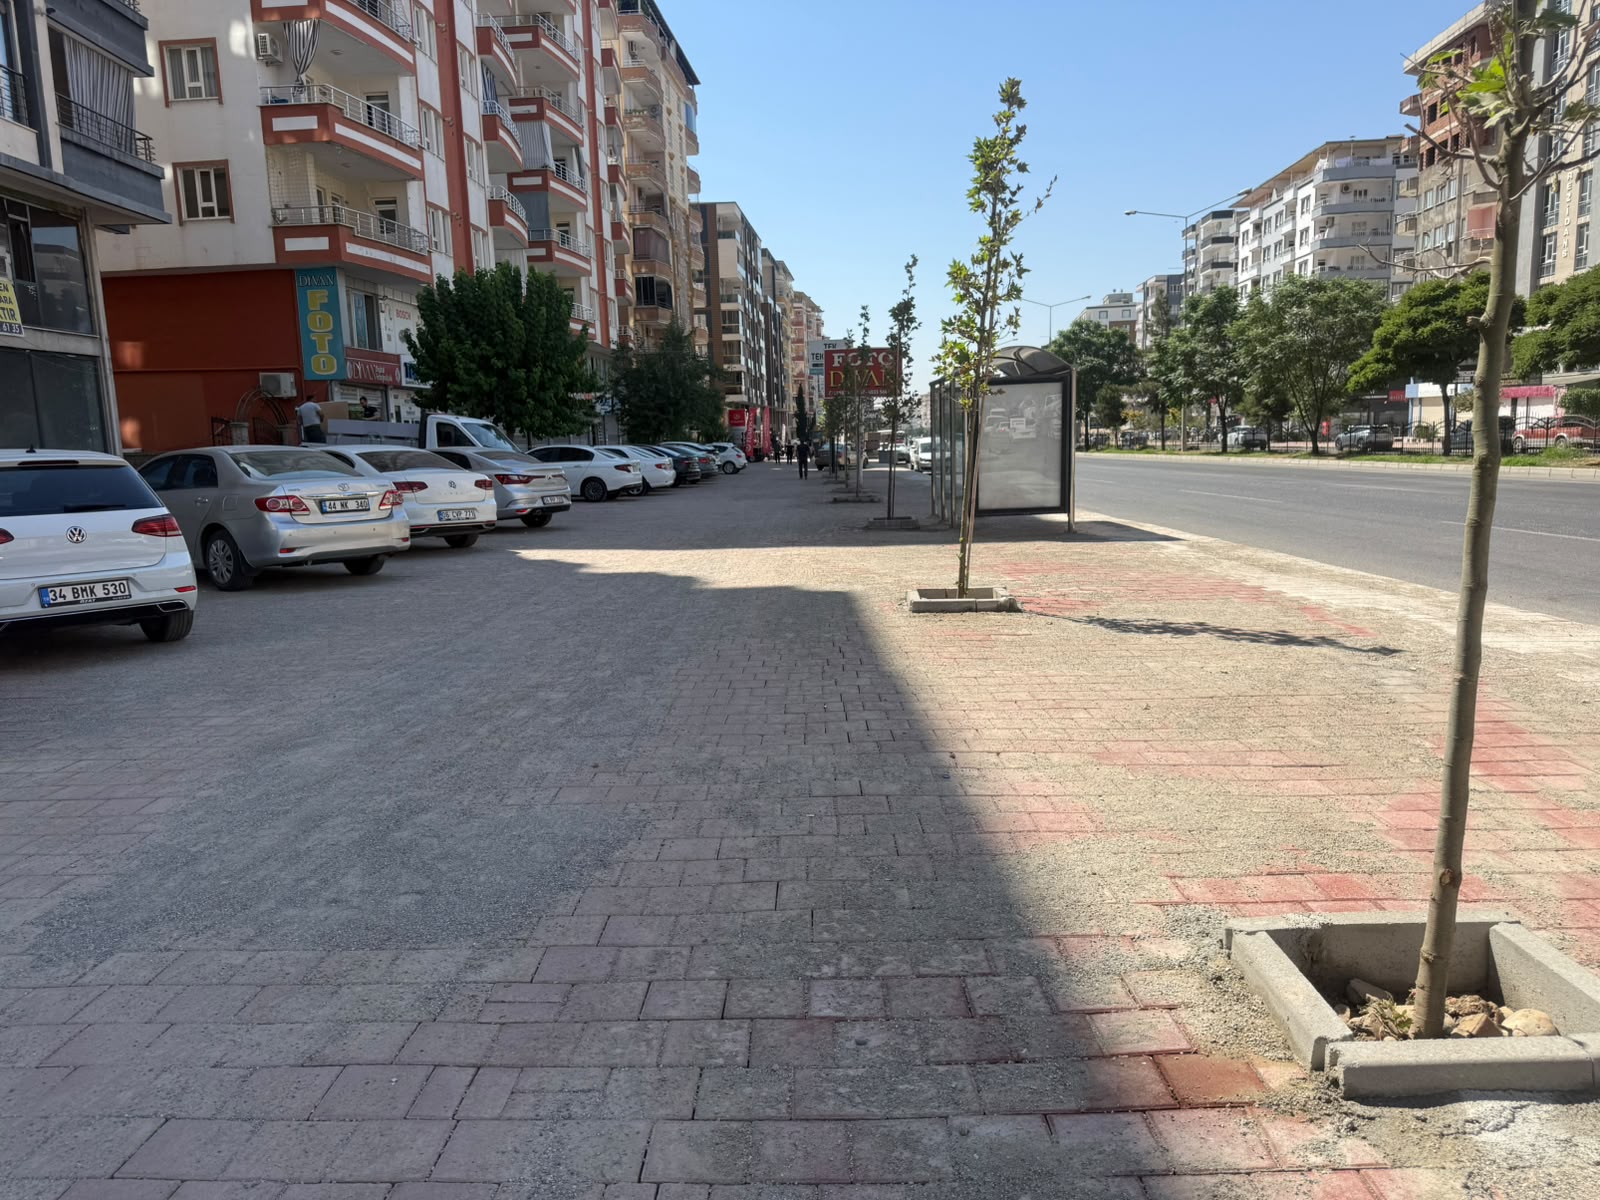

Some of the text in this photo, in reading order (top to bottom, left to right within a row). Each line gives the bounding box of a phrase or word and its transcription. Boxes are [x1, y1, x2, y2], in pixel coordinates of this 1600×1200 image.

[307, 290, 337, 375] FOTO
[49, 582, 126, 601] 34 BMK 530
